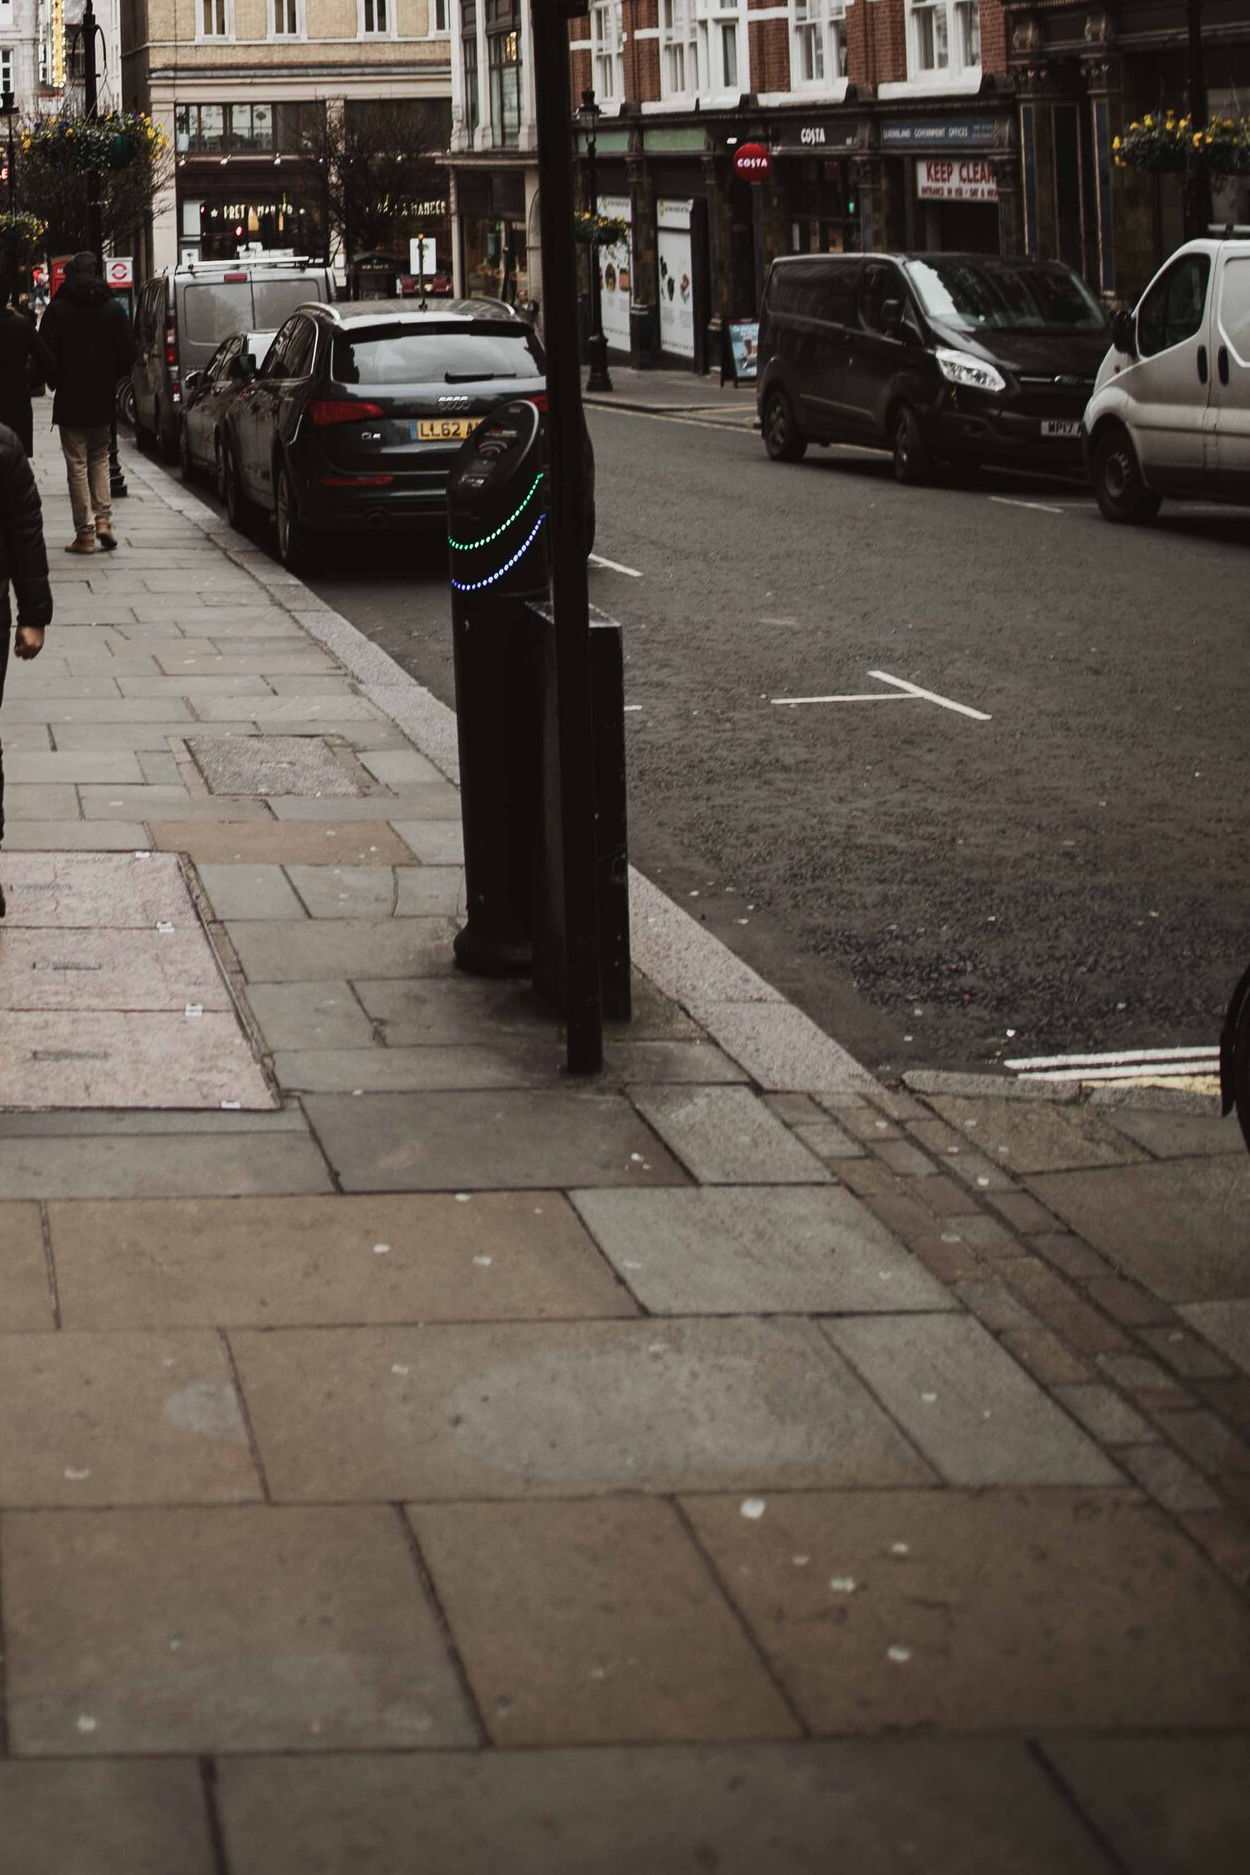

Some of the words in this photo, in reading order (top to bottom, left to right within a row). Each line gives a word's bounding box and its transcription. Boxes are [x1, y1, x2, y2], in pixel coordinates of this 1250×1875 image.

[801, 128, 825, 145] COSTA
[948, 127, 968, 138] OFFICES
[737, 158, 768, 168] COSTA
[926, 161, 953, 183] KEEP
[420, 422, 462, 437] LL62
